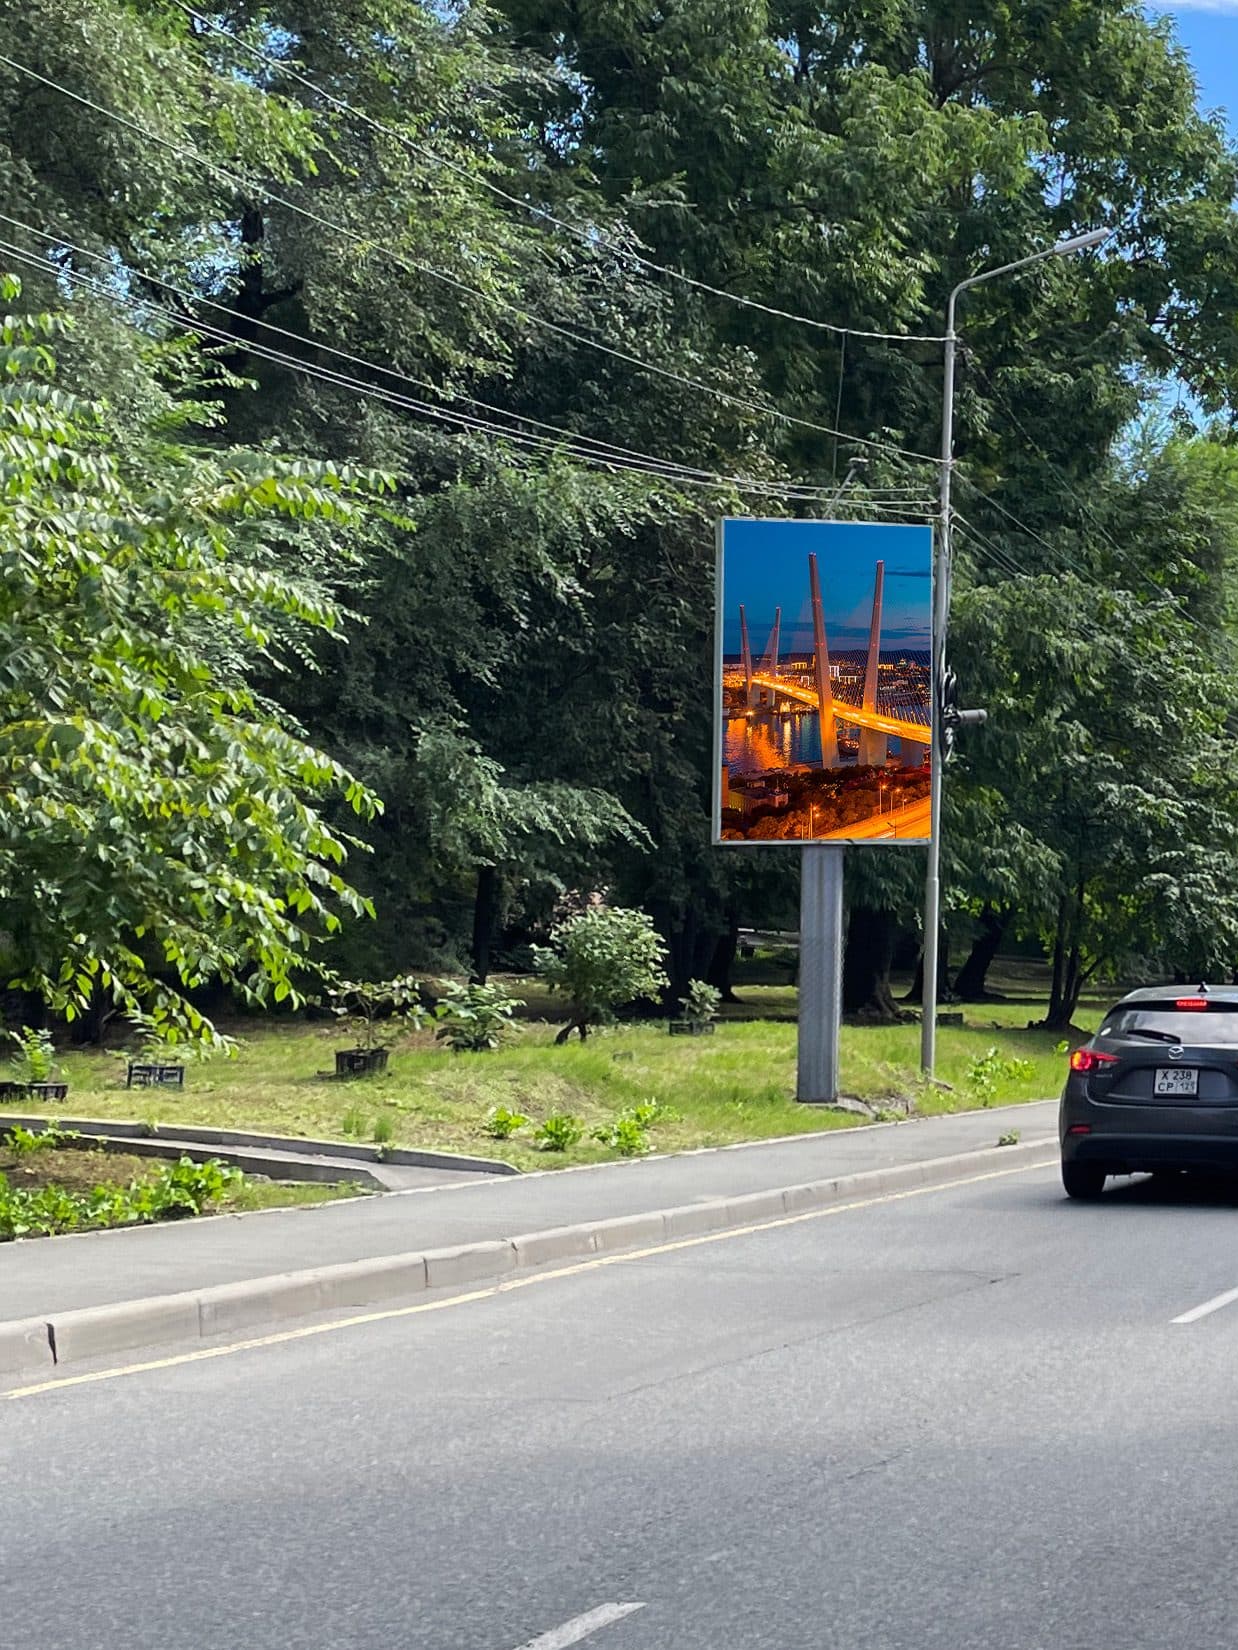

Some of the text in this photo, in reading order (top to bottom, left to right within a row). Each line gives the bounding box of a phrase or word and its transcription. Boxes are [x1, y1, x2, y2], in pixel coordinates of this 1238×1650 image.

[1161, 1071, 1192, 1080] Х 238
[1158, 1083, 1174, 1091] СР
